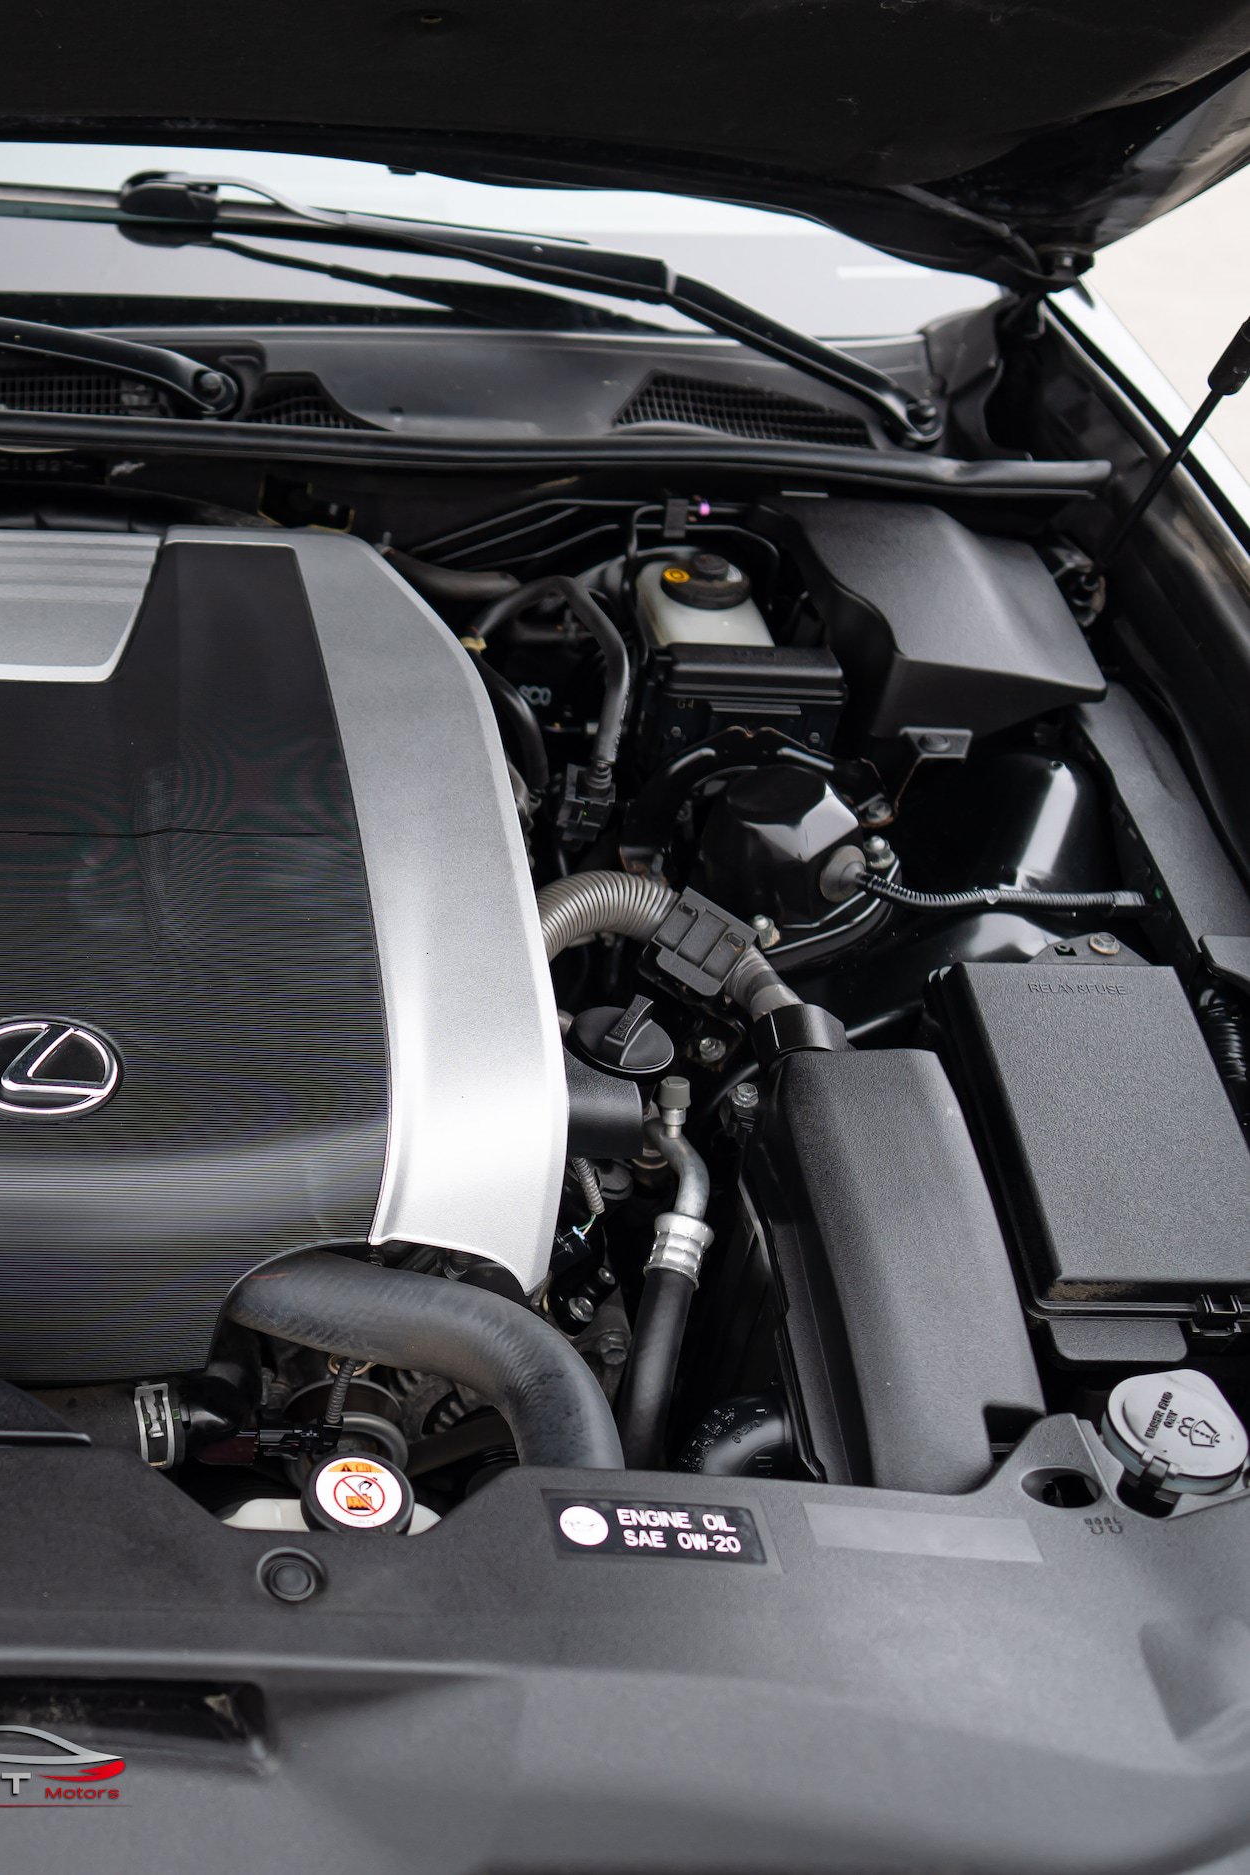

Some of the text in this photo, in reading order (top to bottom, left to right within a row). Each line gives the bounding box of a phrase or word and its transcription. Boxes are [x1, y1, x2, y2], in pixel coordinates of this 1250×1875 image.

[616, 1508, 737, 1533] ENGINE OIL
[623, 1530, 742, 1553] SAE 0W-20
